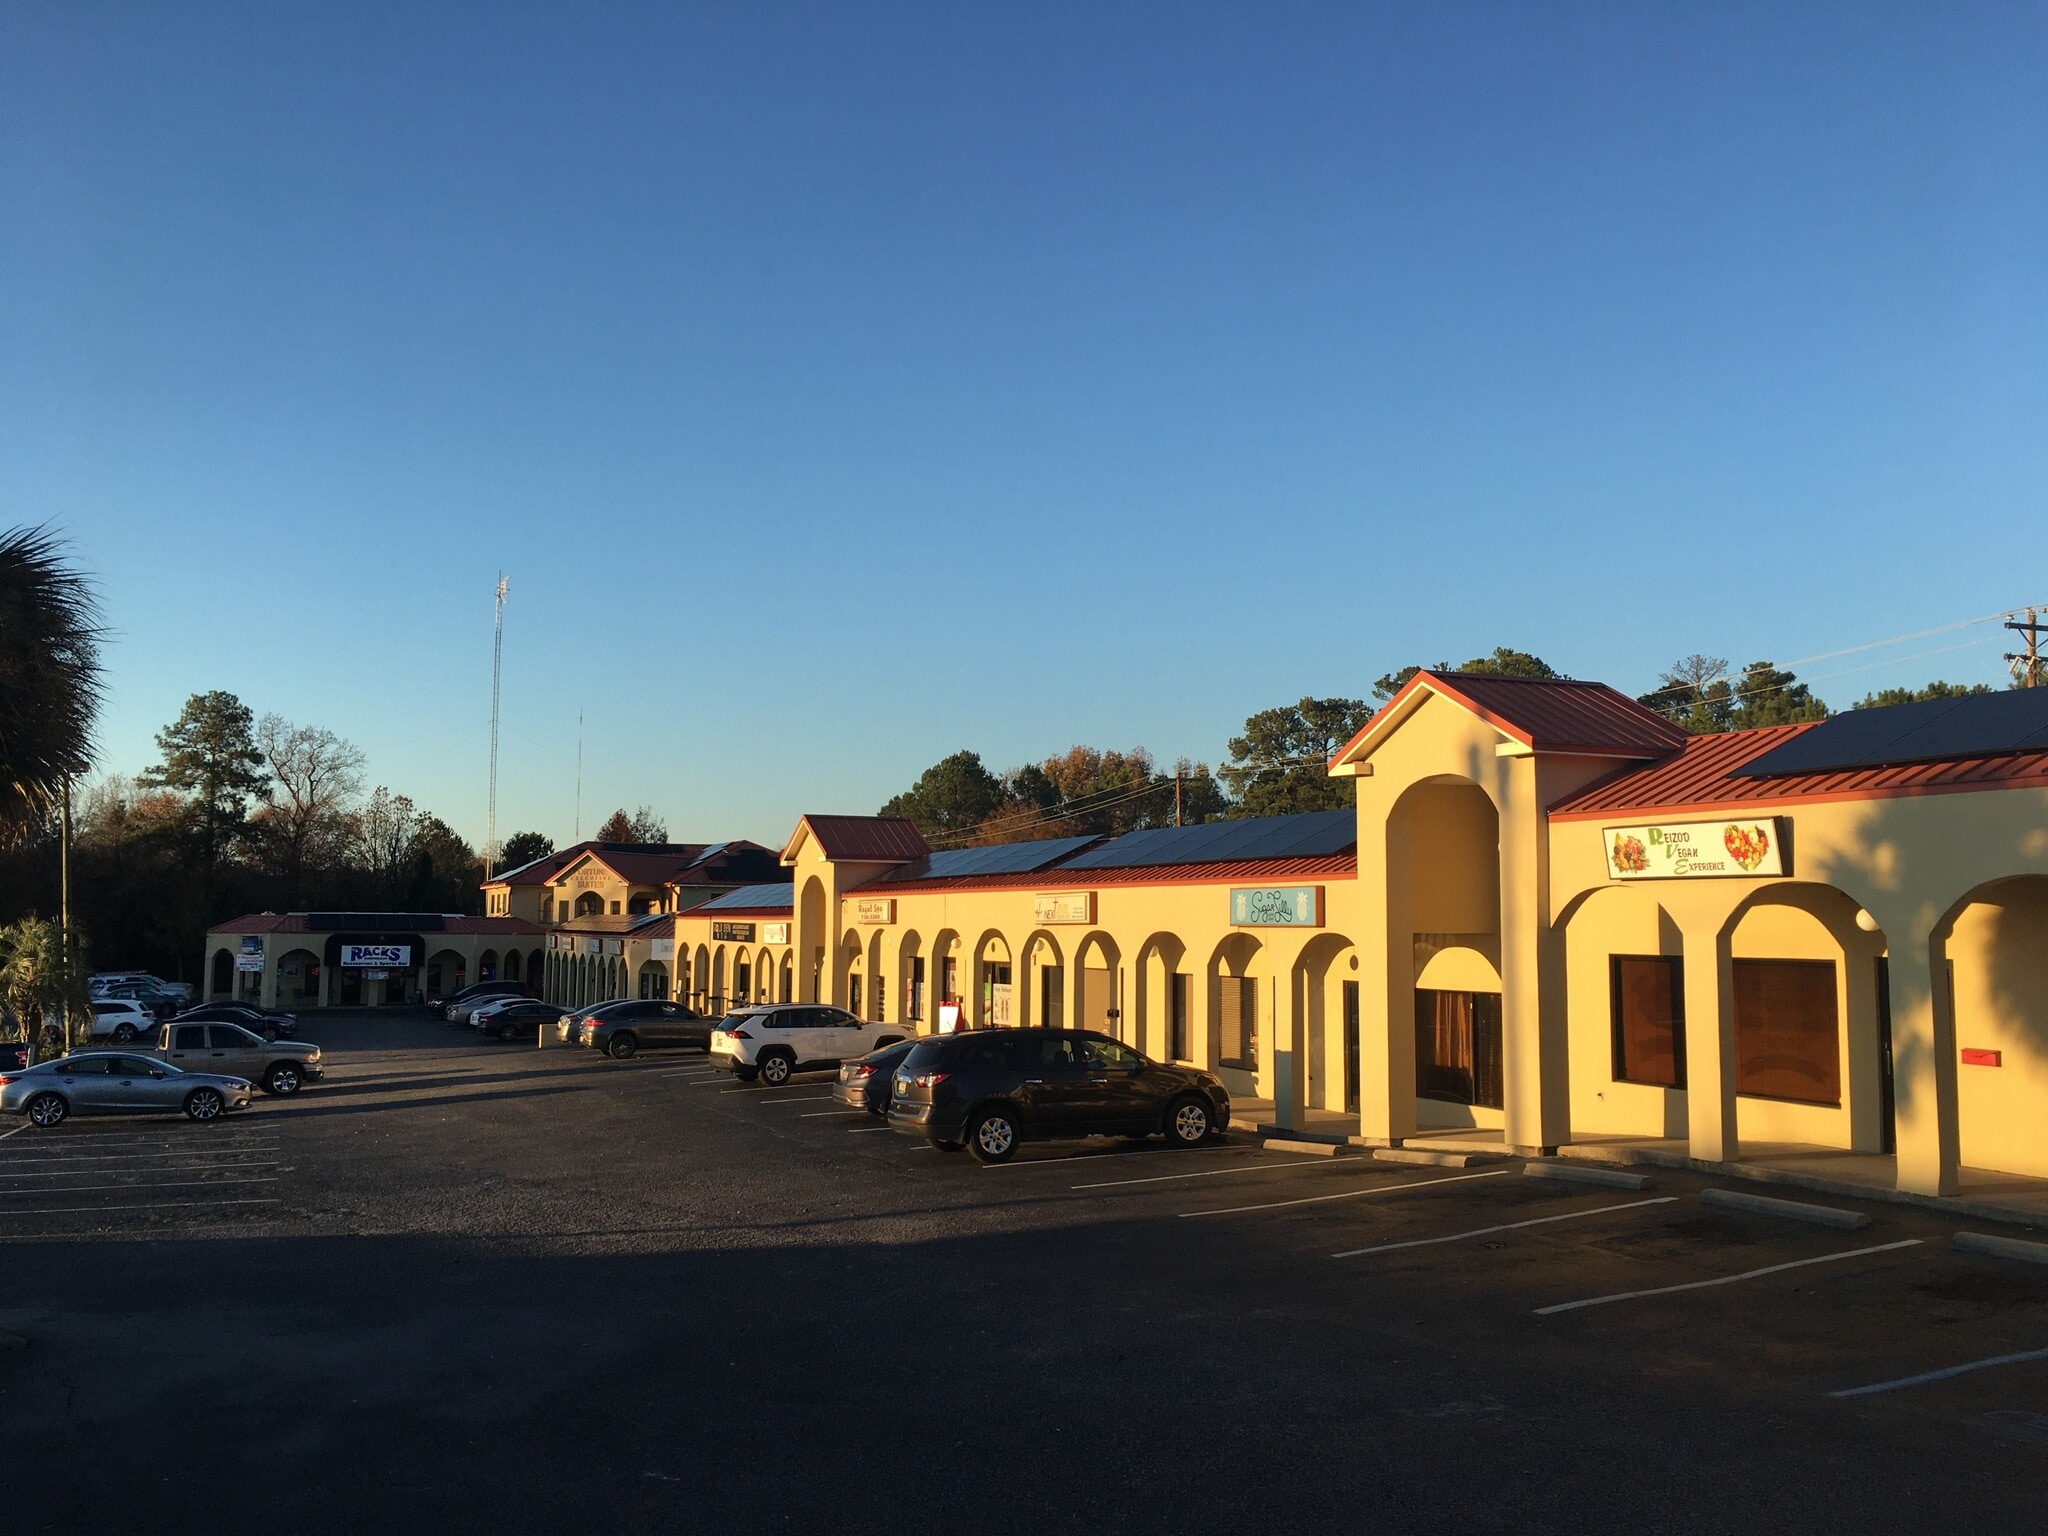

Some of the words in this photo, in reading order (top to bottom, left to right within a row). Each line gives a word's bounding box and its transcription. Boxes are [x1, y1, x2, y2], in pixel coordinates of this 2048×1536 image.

[576, 868, 608, 876] ORTUNE
[873, 904, 883, 913] Spa
[350, 946, 401, 961] RACKS
